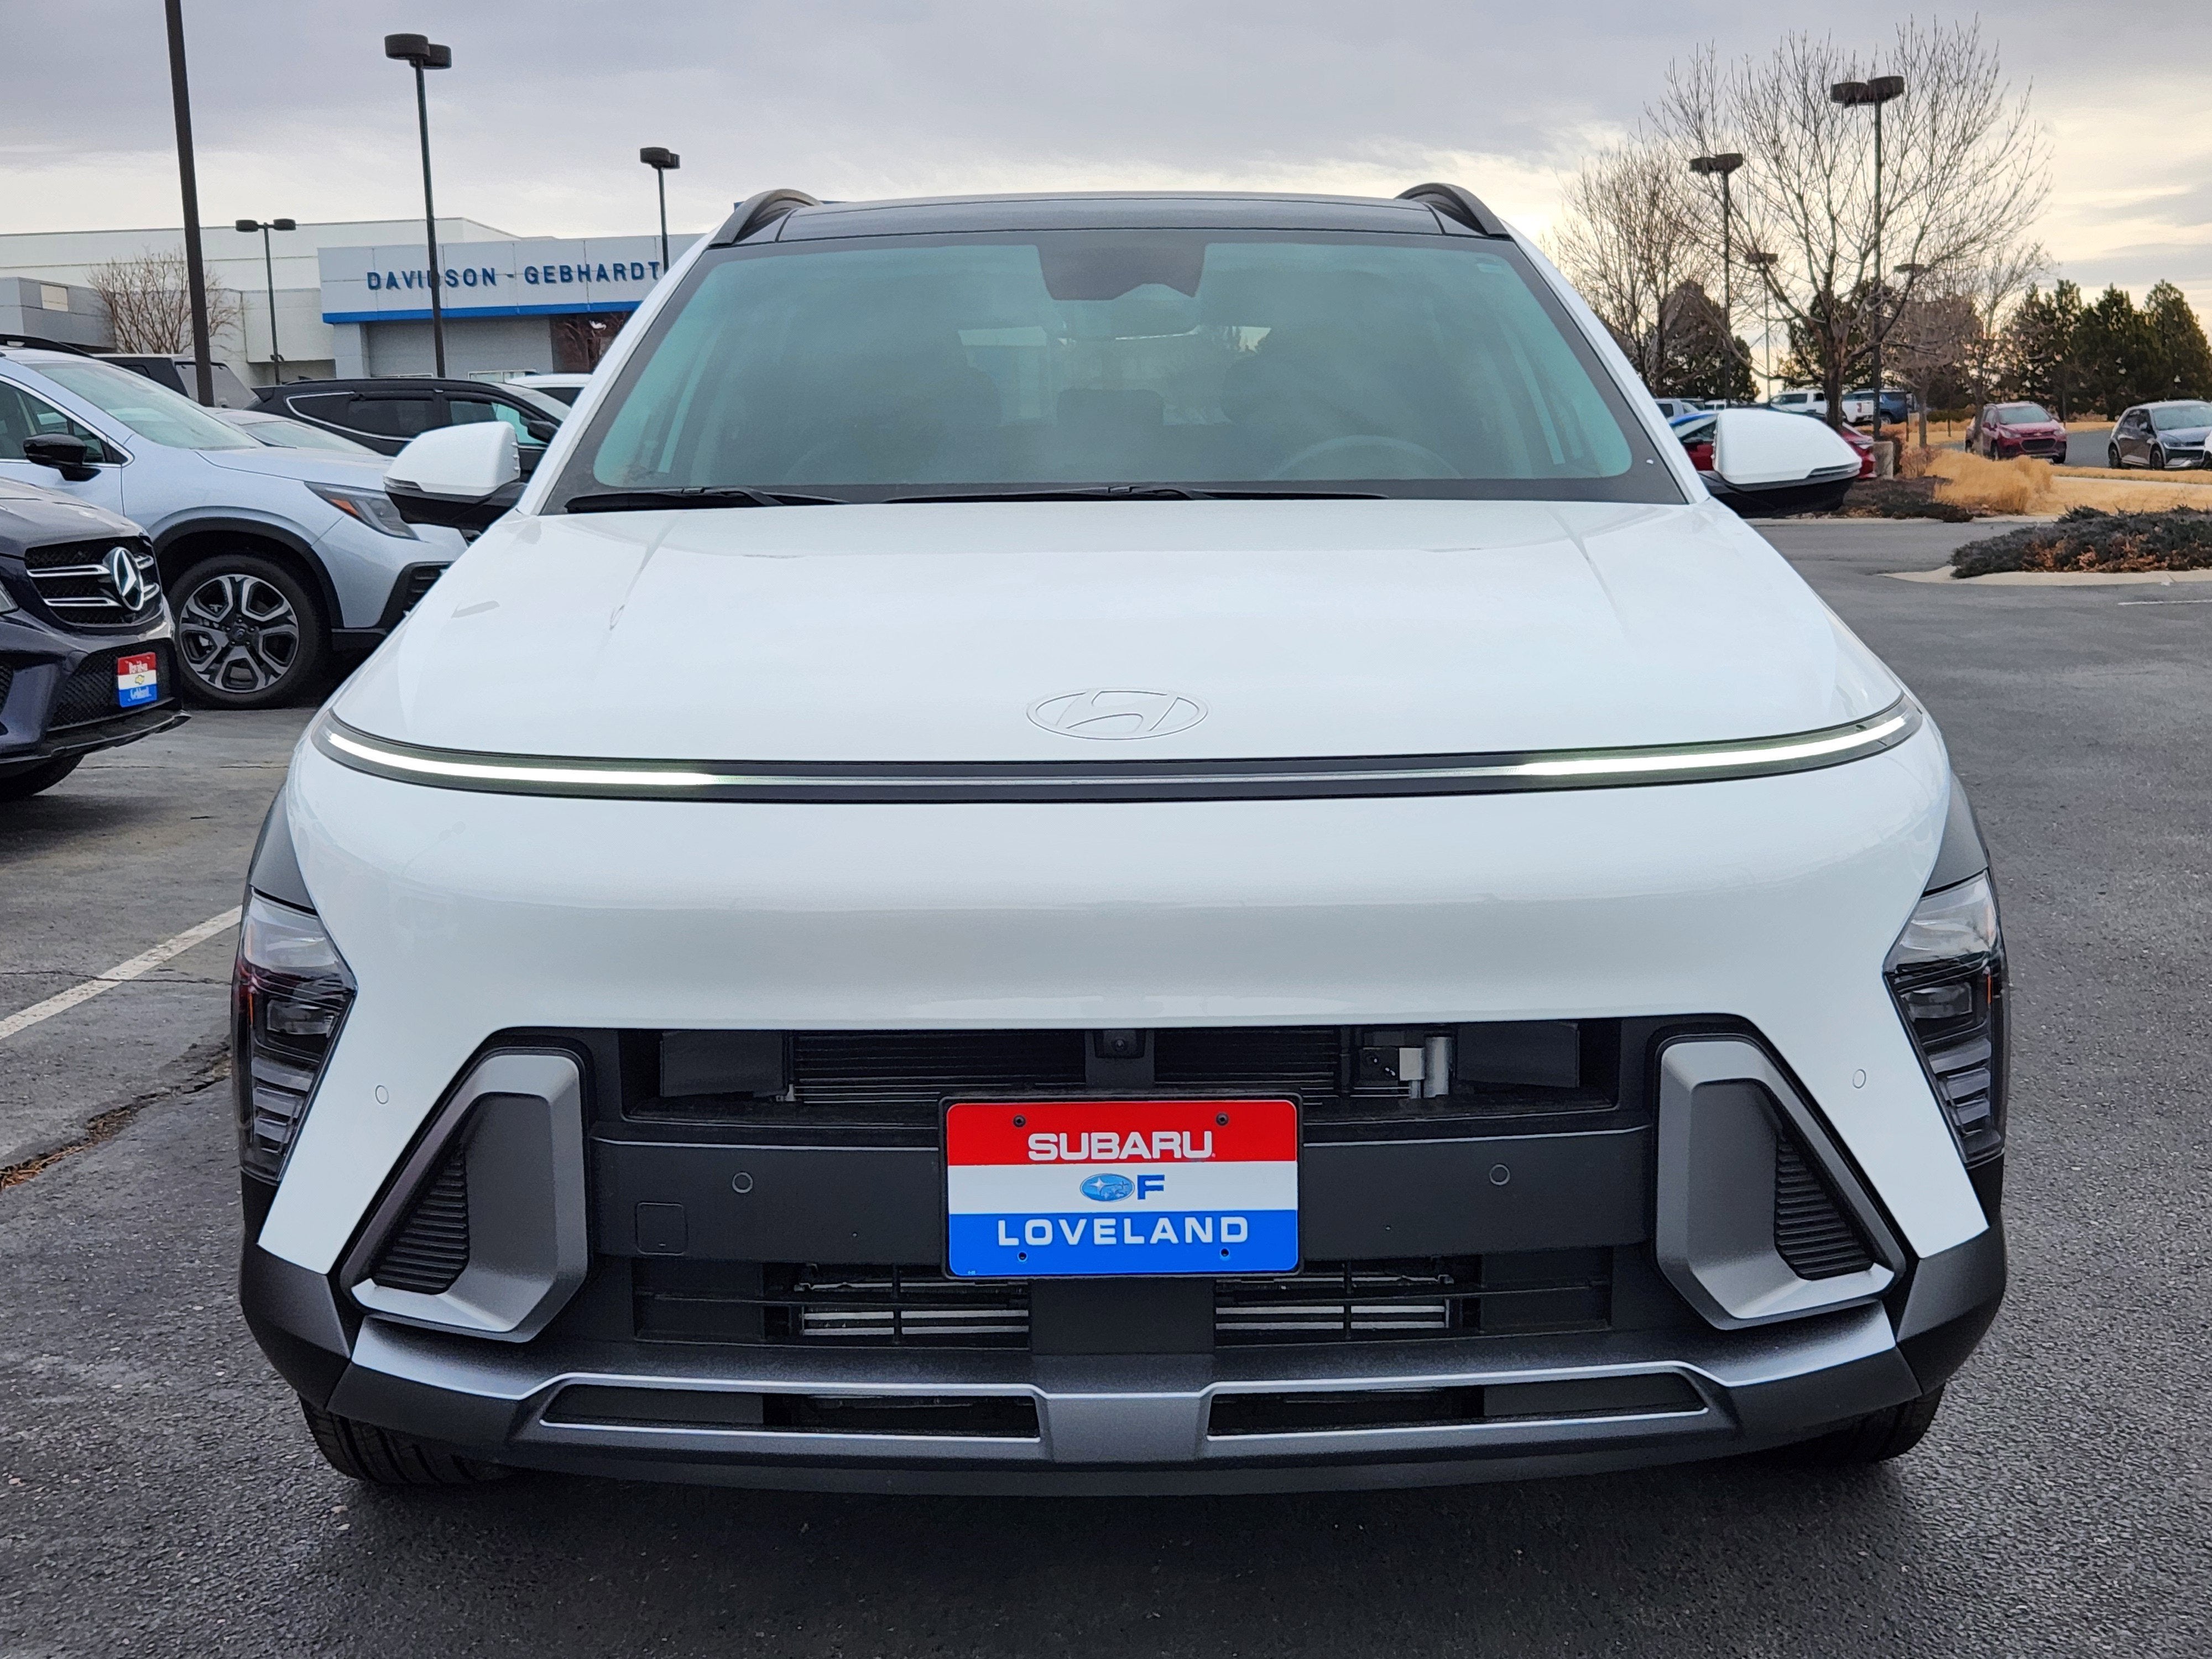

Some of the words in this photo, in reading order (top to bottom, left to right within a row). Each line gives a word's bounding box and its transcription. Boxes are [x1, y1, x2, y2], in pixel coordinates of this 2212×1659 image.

[524, 261, 660, 285] GEBHARDT
[1028, 1131, 1213, 1160] SUBARU
[998, 1217, 1248, 1246] LOVELAND
